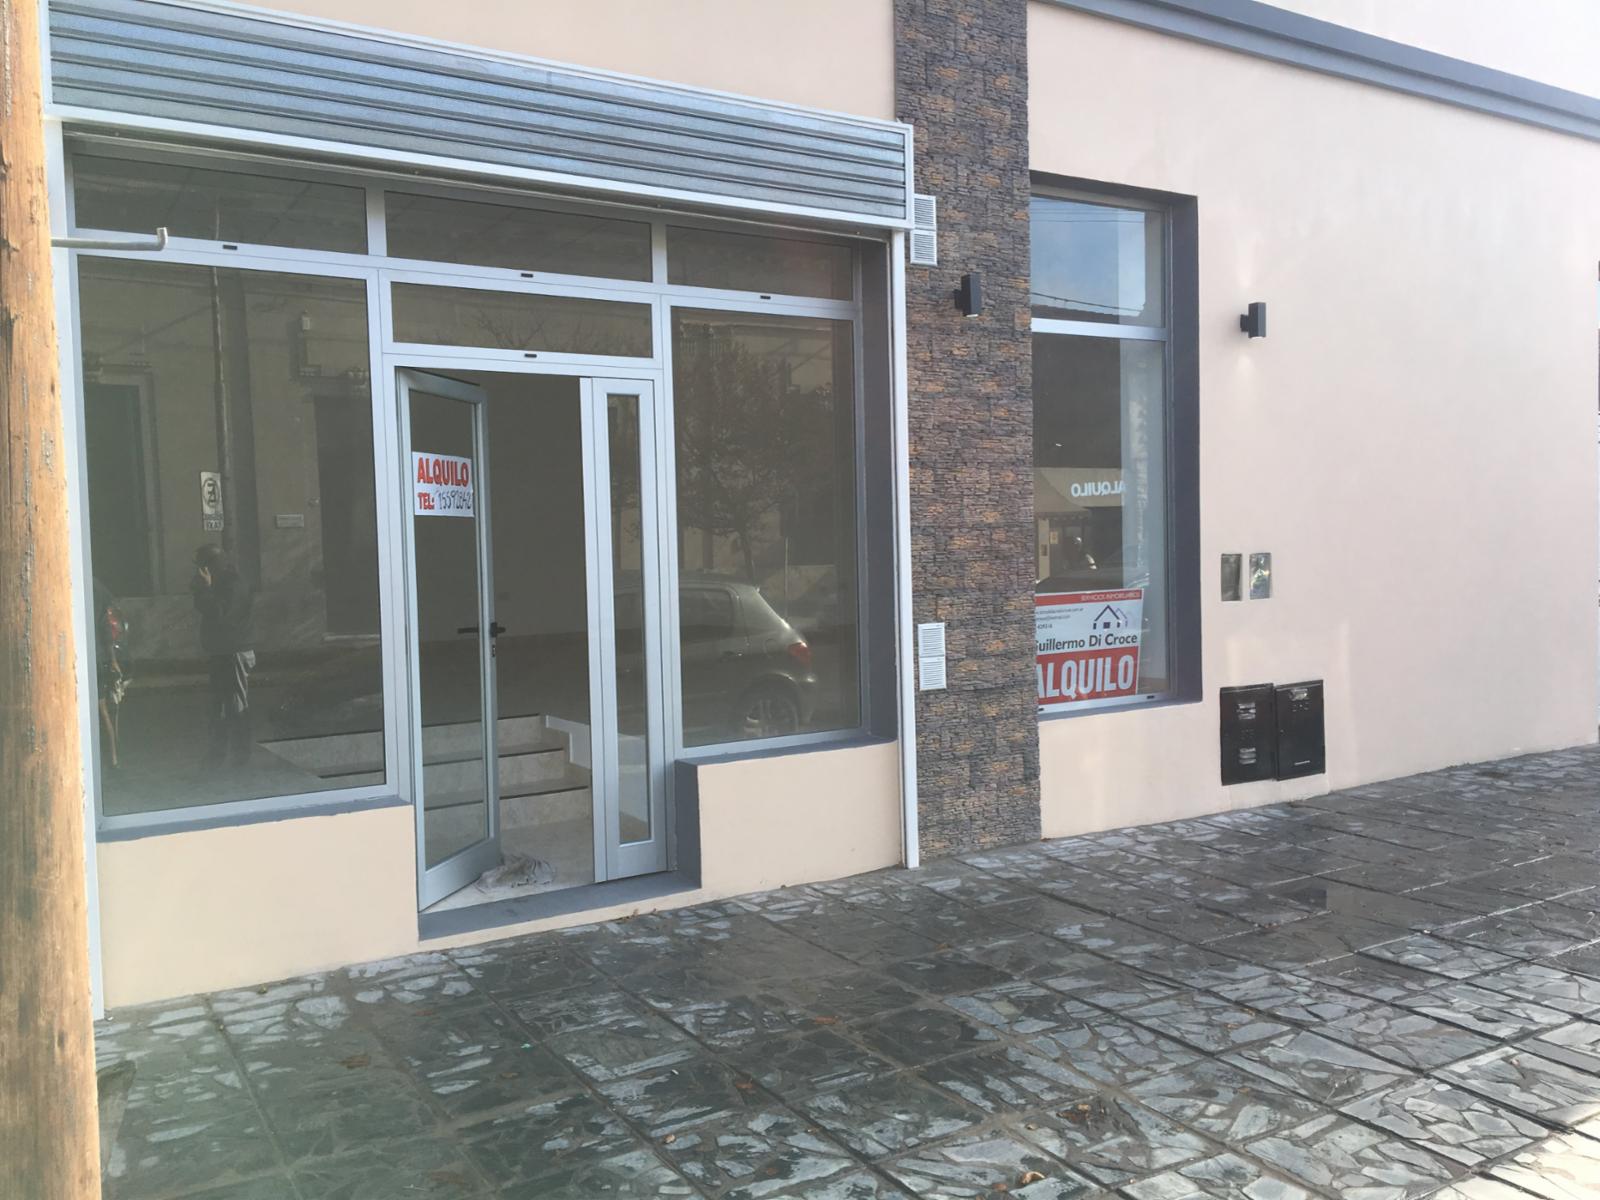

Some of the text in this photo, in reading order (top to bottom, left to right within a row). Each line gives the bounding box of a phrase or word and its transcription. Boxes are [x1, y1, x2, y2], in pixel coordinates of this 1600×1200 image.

[417, 457, 469, 487] ALQUILO
[417, 492, 435, 510] TEL:
[1089, 634, 1101, 647] Di
[1104, 633, 1138, 646] Croce
